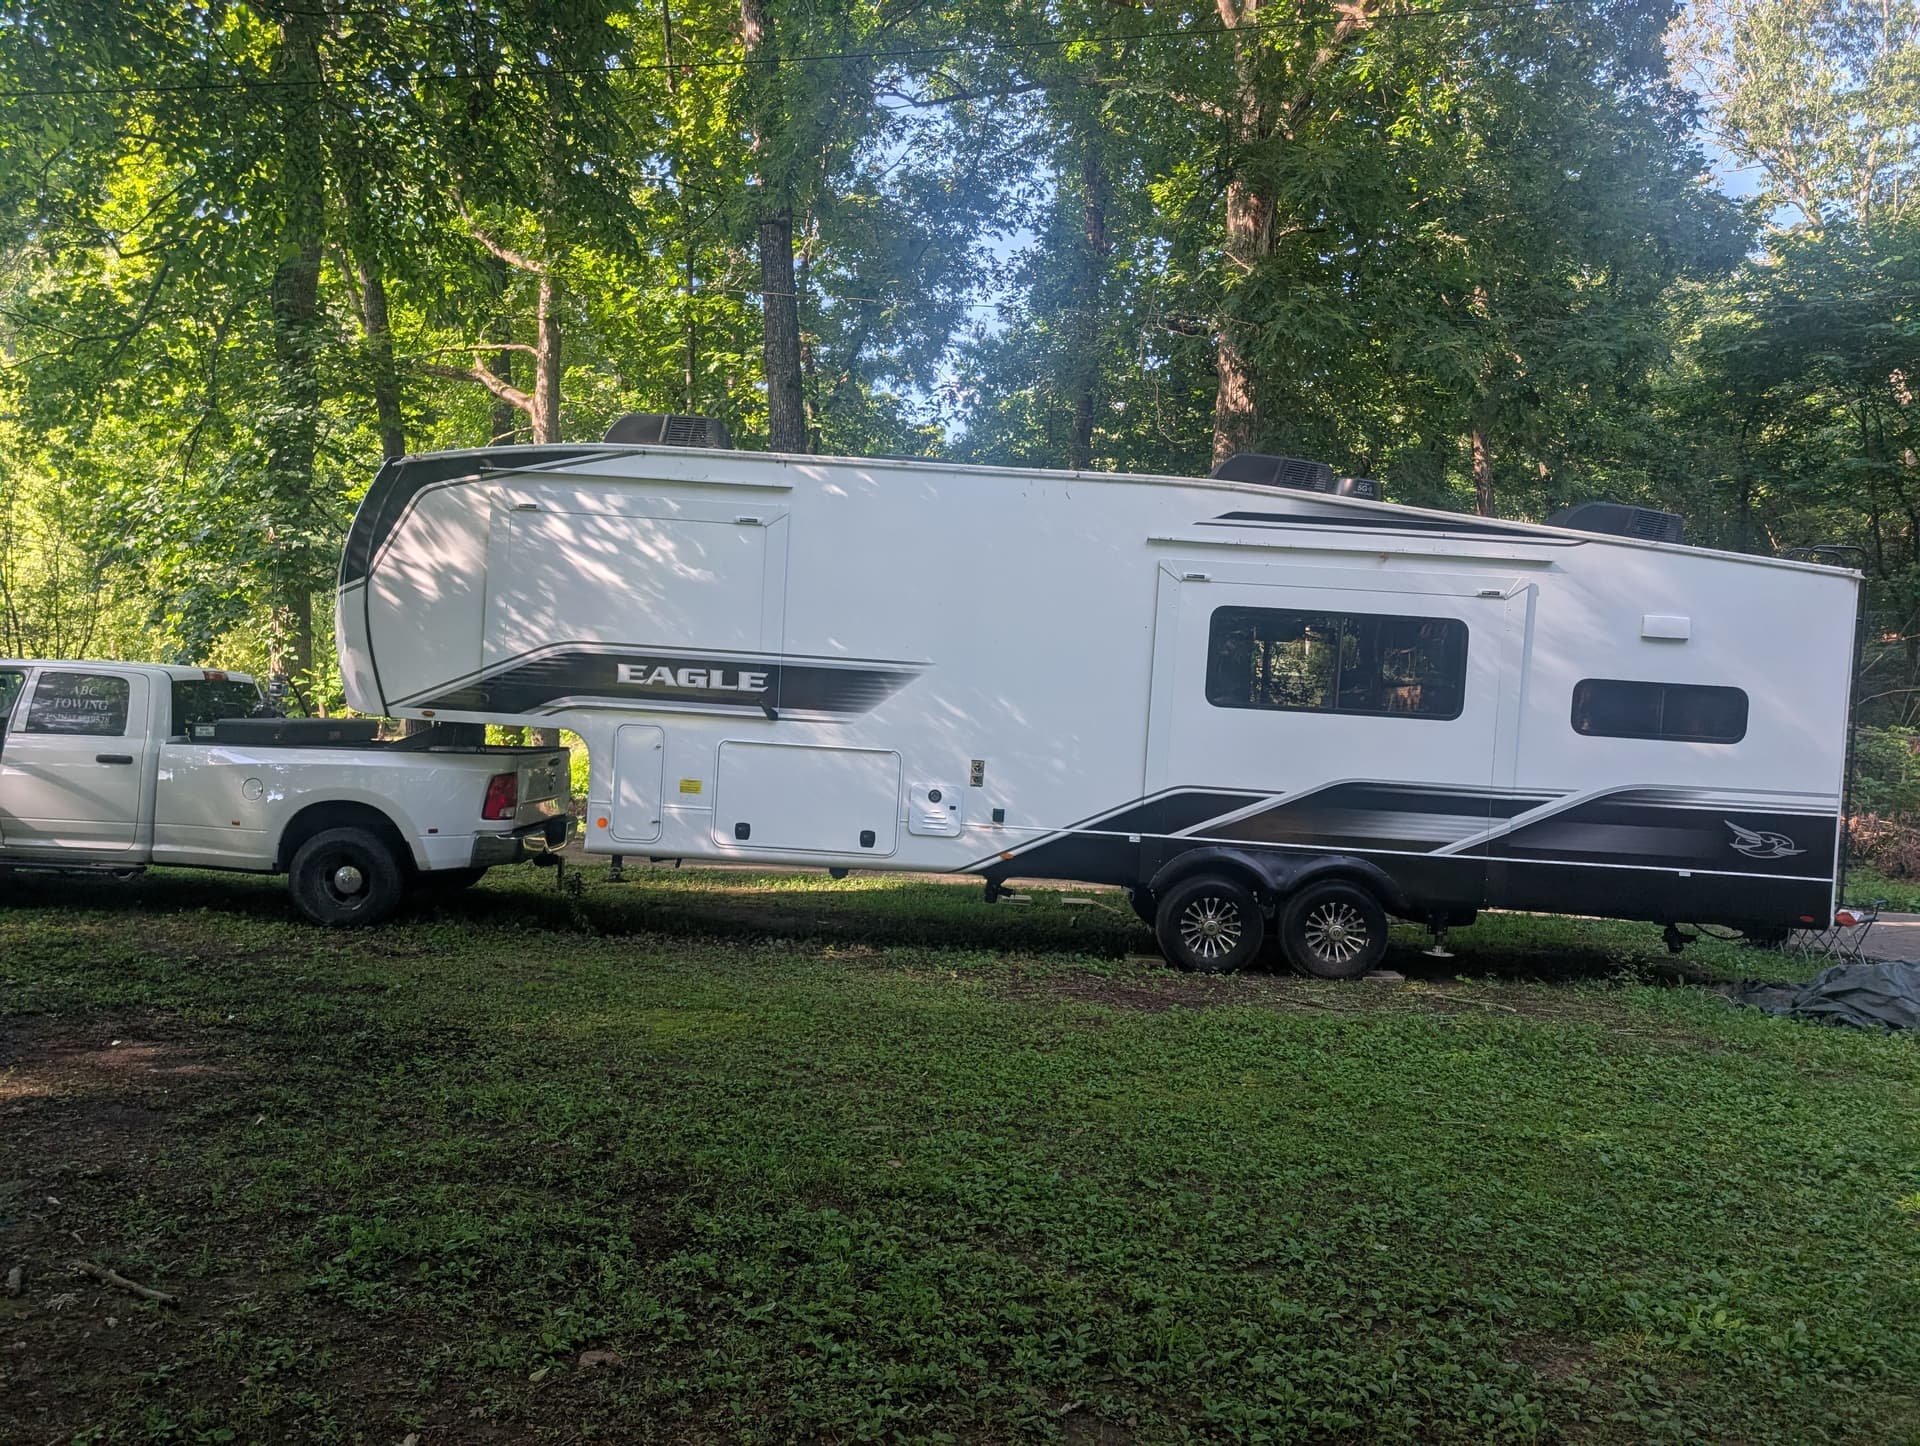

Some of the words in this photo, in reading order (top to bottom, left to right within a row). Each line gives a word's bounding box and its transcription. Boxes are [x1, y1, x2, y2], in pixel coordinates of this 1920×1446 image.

[617, 663, 768, 692] EAGLE
[70, 685, 98, 696] ABC
[54, 697, 109, 710] TOWING
